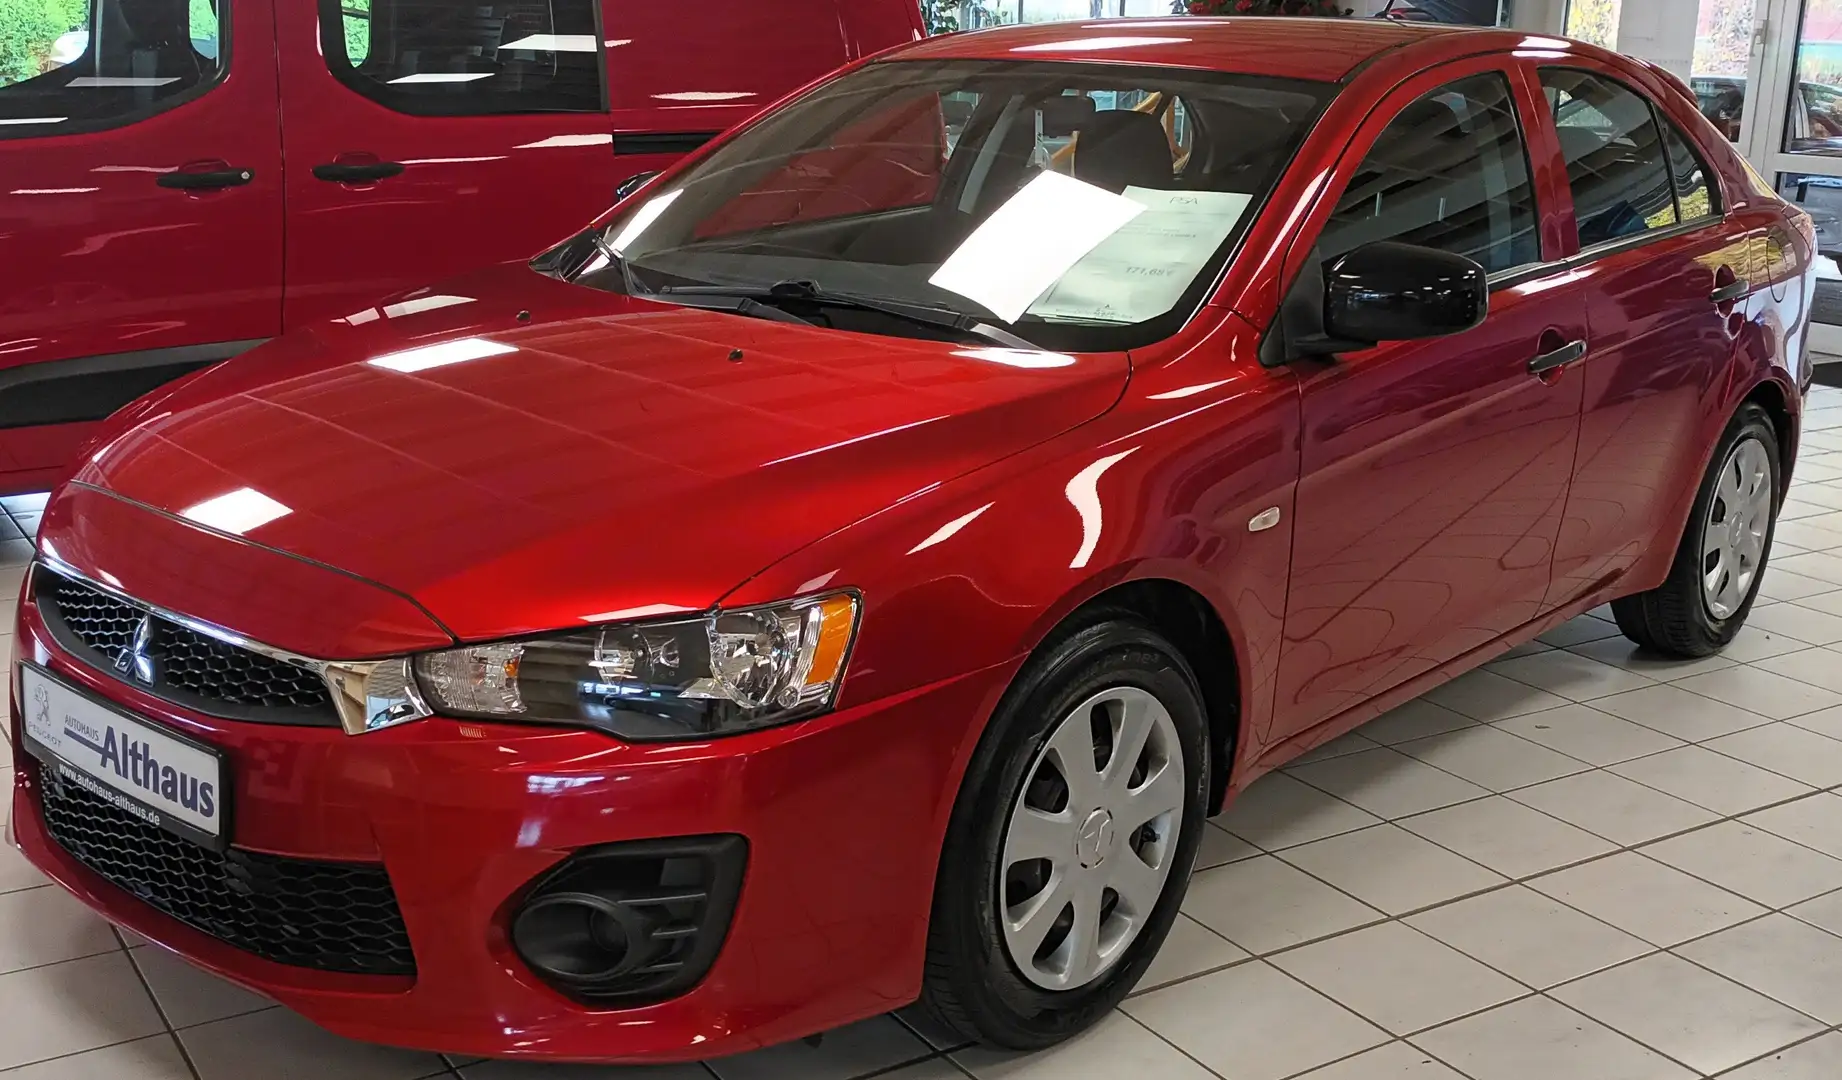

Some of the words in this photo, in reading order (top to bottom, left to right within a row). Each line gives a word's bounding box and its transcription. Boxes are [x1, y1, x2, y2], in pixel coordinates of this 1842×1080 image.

[28, 721, 62, 747] PEUGEOT
[64, 714, 100, 742] AUTOHAUS
[58, 762, 161, 827] www.autohaus-althaus.de
[100, 725, 215, 818] Althaus
